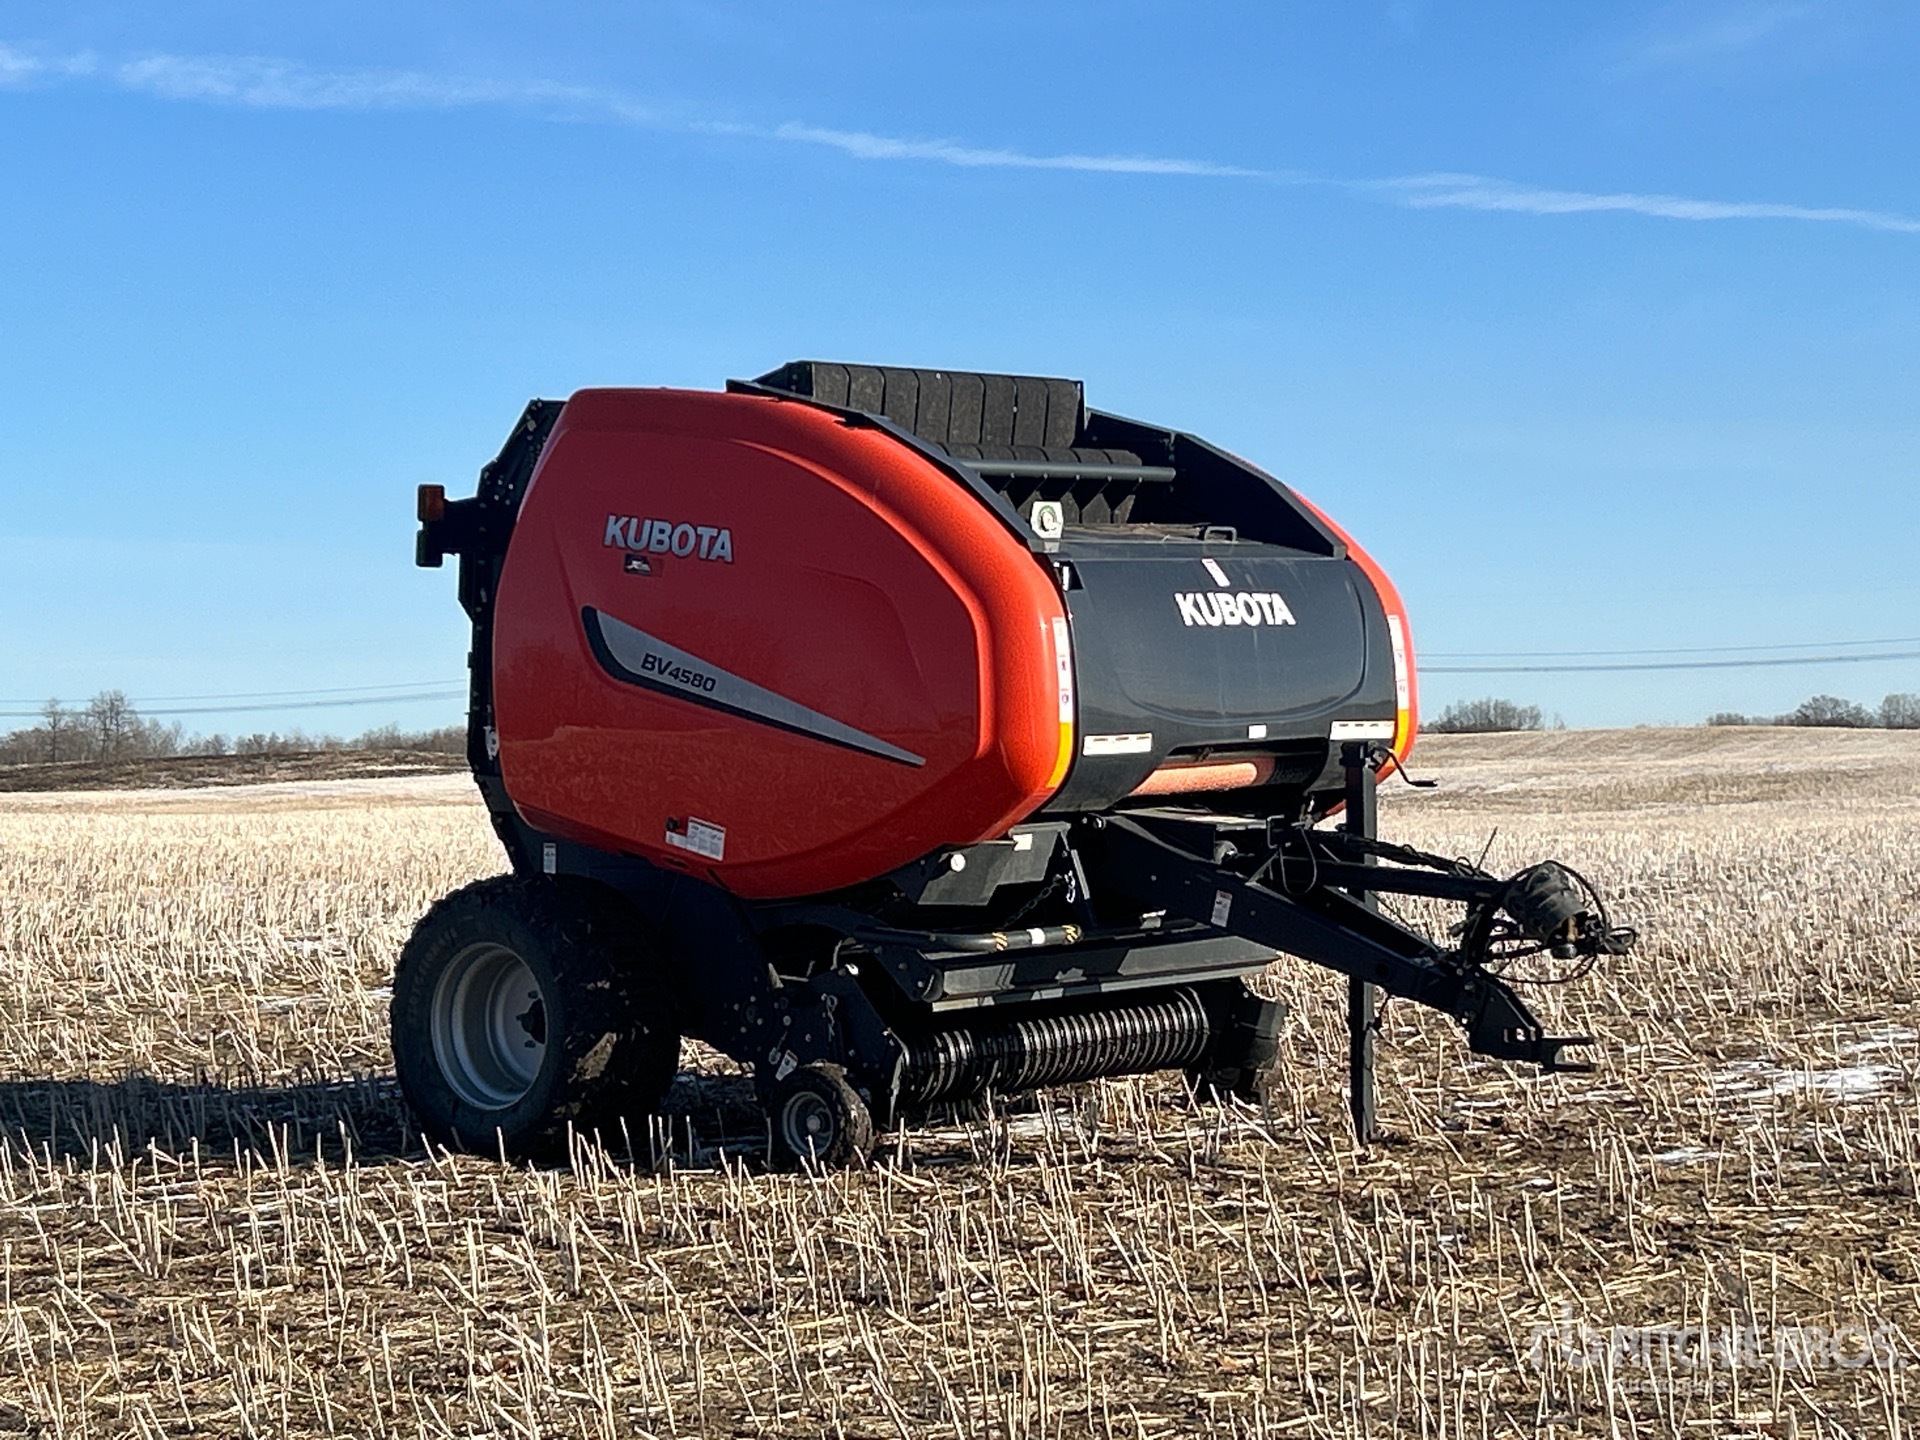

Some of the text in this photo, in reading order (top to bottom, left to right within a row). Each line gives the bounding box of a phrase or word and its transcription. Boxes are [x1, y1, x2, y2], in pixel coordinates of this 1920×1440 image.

[604, 515, 733, 563] KUBOTA
[1174, 592, 1297, 627] KUBOTA
[640, 652, 717, 692] BV4580
